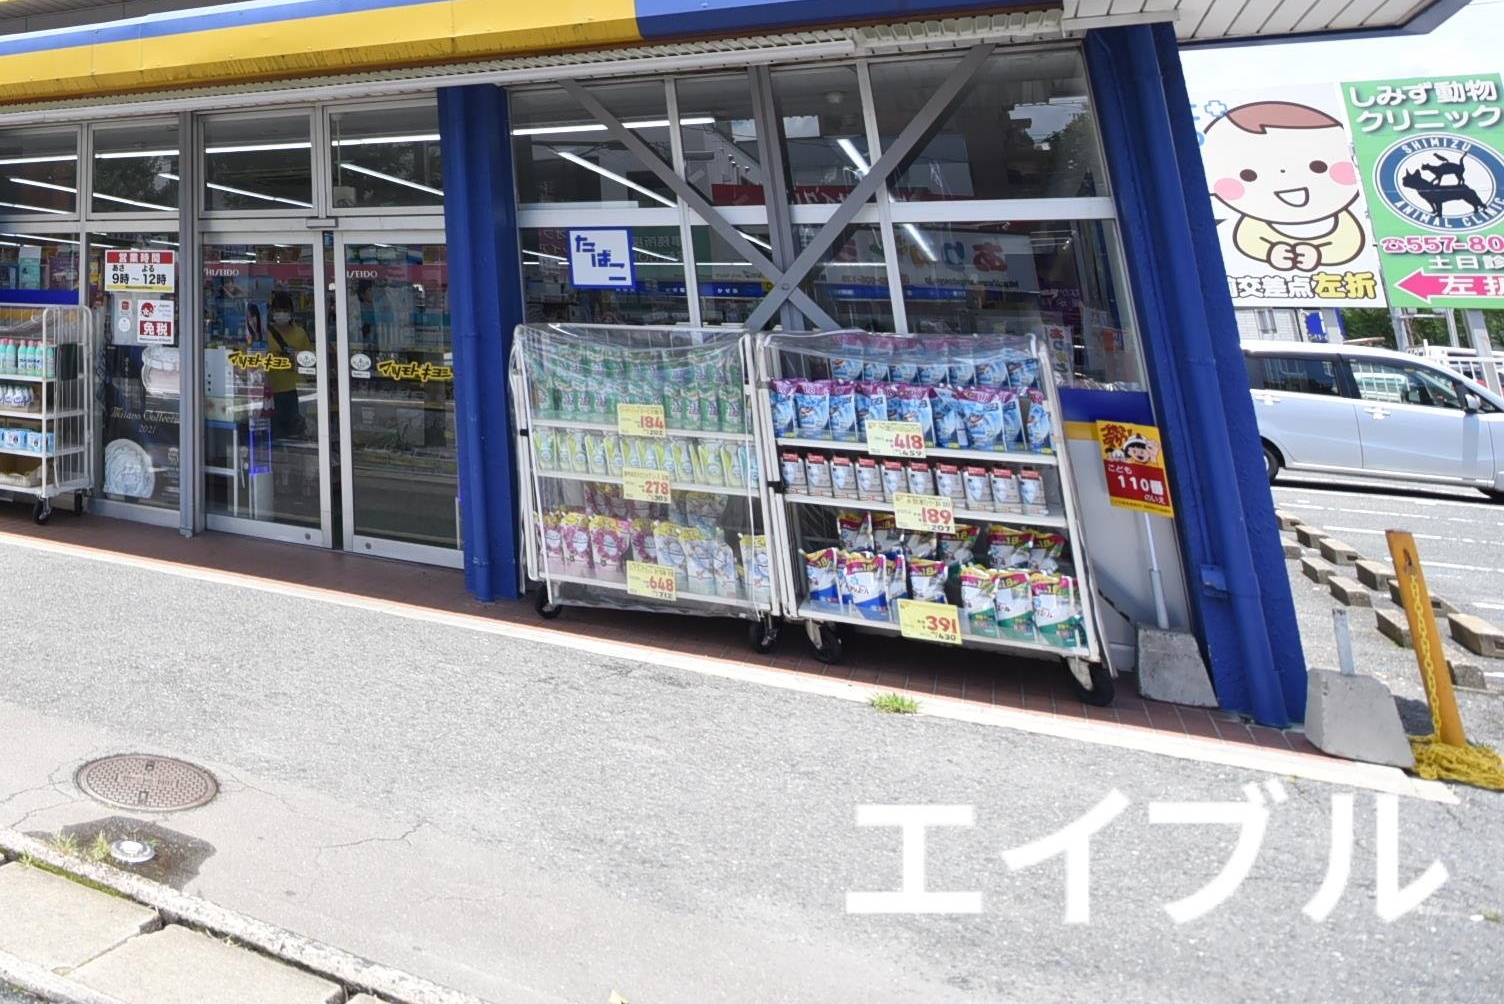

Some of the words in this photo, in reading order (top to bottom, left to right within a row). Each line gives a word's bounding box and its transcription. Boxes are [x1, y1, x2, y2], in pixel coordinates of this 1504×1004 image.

[1349, 79, 1499, 108] しみず動物
[1356, 104, 1502, 133] クリニック
[1400, 137, 1472, 155] SHIMIZU
[1394, 200, 1453, 228] ANIMAL
[118, 252, 161, 263] 営業時間
[112, 264, 125, 272] あさ
[142, 264, 155, 273] よる
[346, 269, 378, 279] ISEIDO
[143, 322, 168, 336] 免税
[228, 351, 292, 370] マツモトキヨシ
[378, 360, 453, 380] マツモトキヨシ
[640, 415, 664, 429] 184
[894, 433, 924, 449] 418
[1107, 463, 1132, 475] こども
[645, 480, 669, 495] 278
[921, 507, 952, 524] 189
[649, 576, 674, 592] 648
[925, 615, 958, 634] 391
